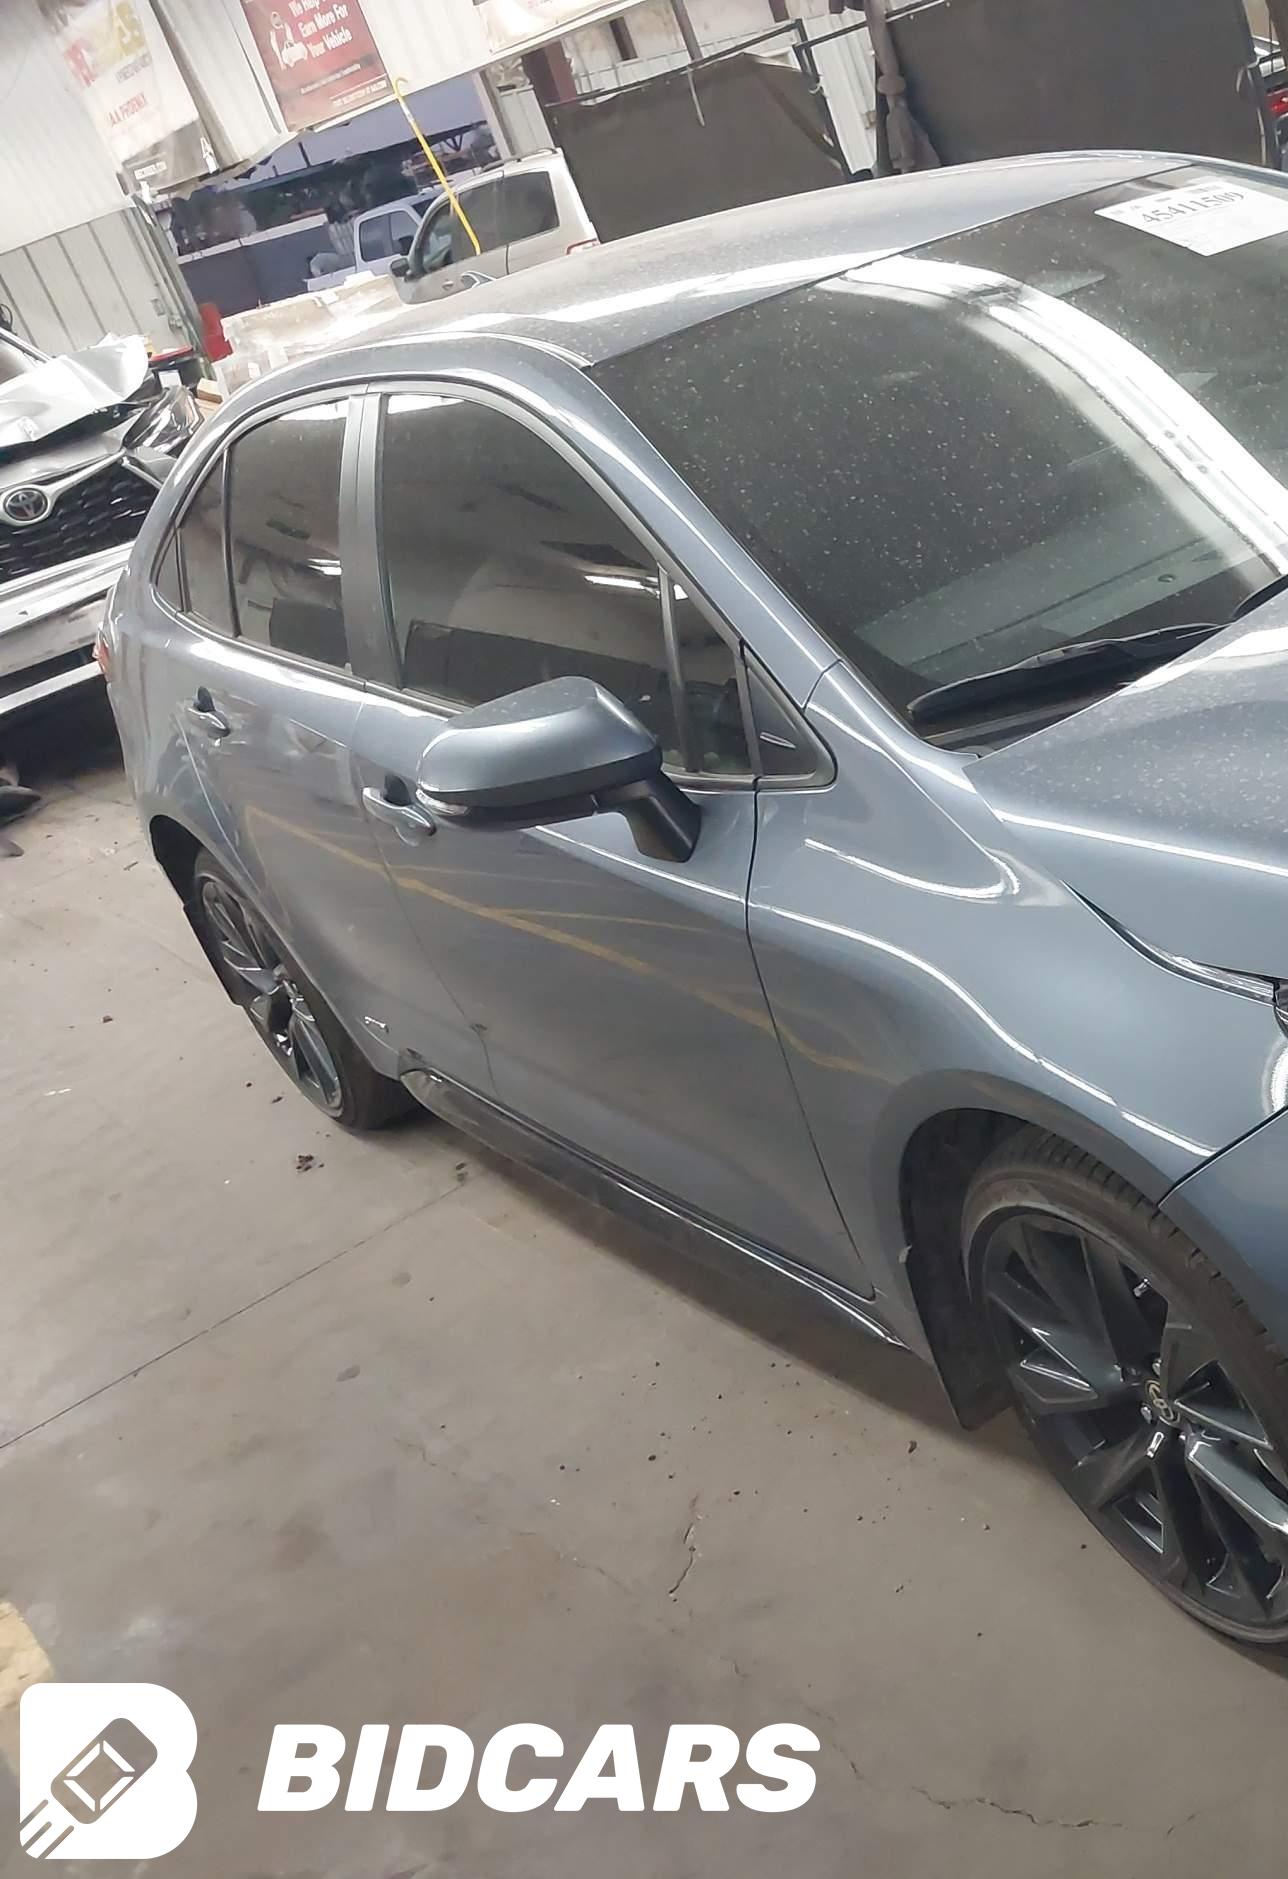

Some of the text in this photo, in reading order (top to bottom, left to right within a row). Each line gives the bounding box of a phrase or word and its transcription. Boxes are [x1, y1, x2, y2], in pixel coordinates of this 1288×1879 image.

[297, 3, 349, 38] Earn More For
[306, 25, 353, 58] Your Vehicle
